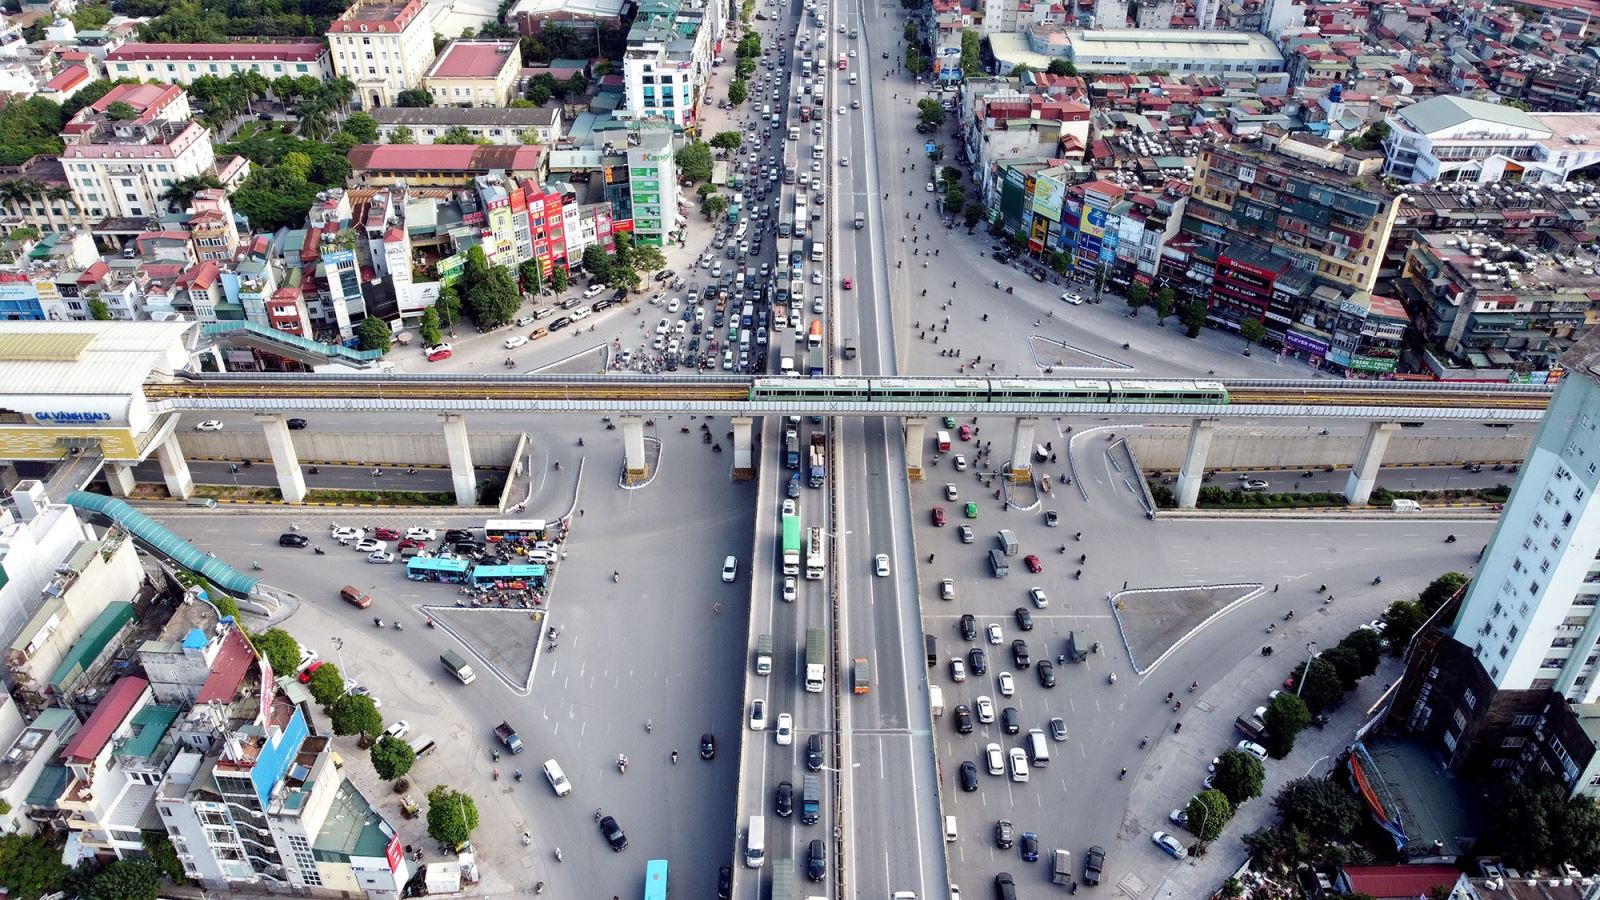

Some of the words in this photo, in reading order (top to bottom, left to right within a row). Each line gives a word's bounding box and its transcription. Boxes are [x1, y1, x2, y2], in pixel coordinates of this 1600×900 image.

[35, 411, 51, 421] GA
[51, 410, 82, 421] VÀNH
[103, 412, 111, 421] 3
